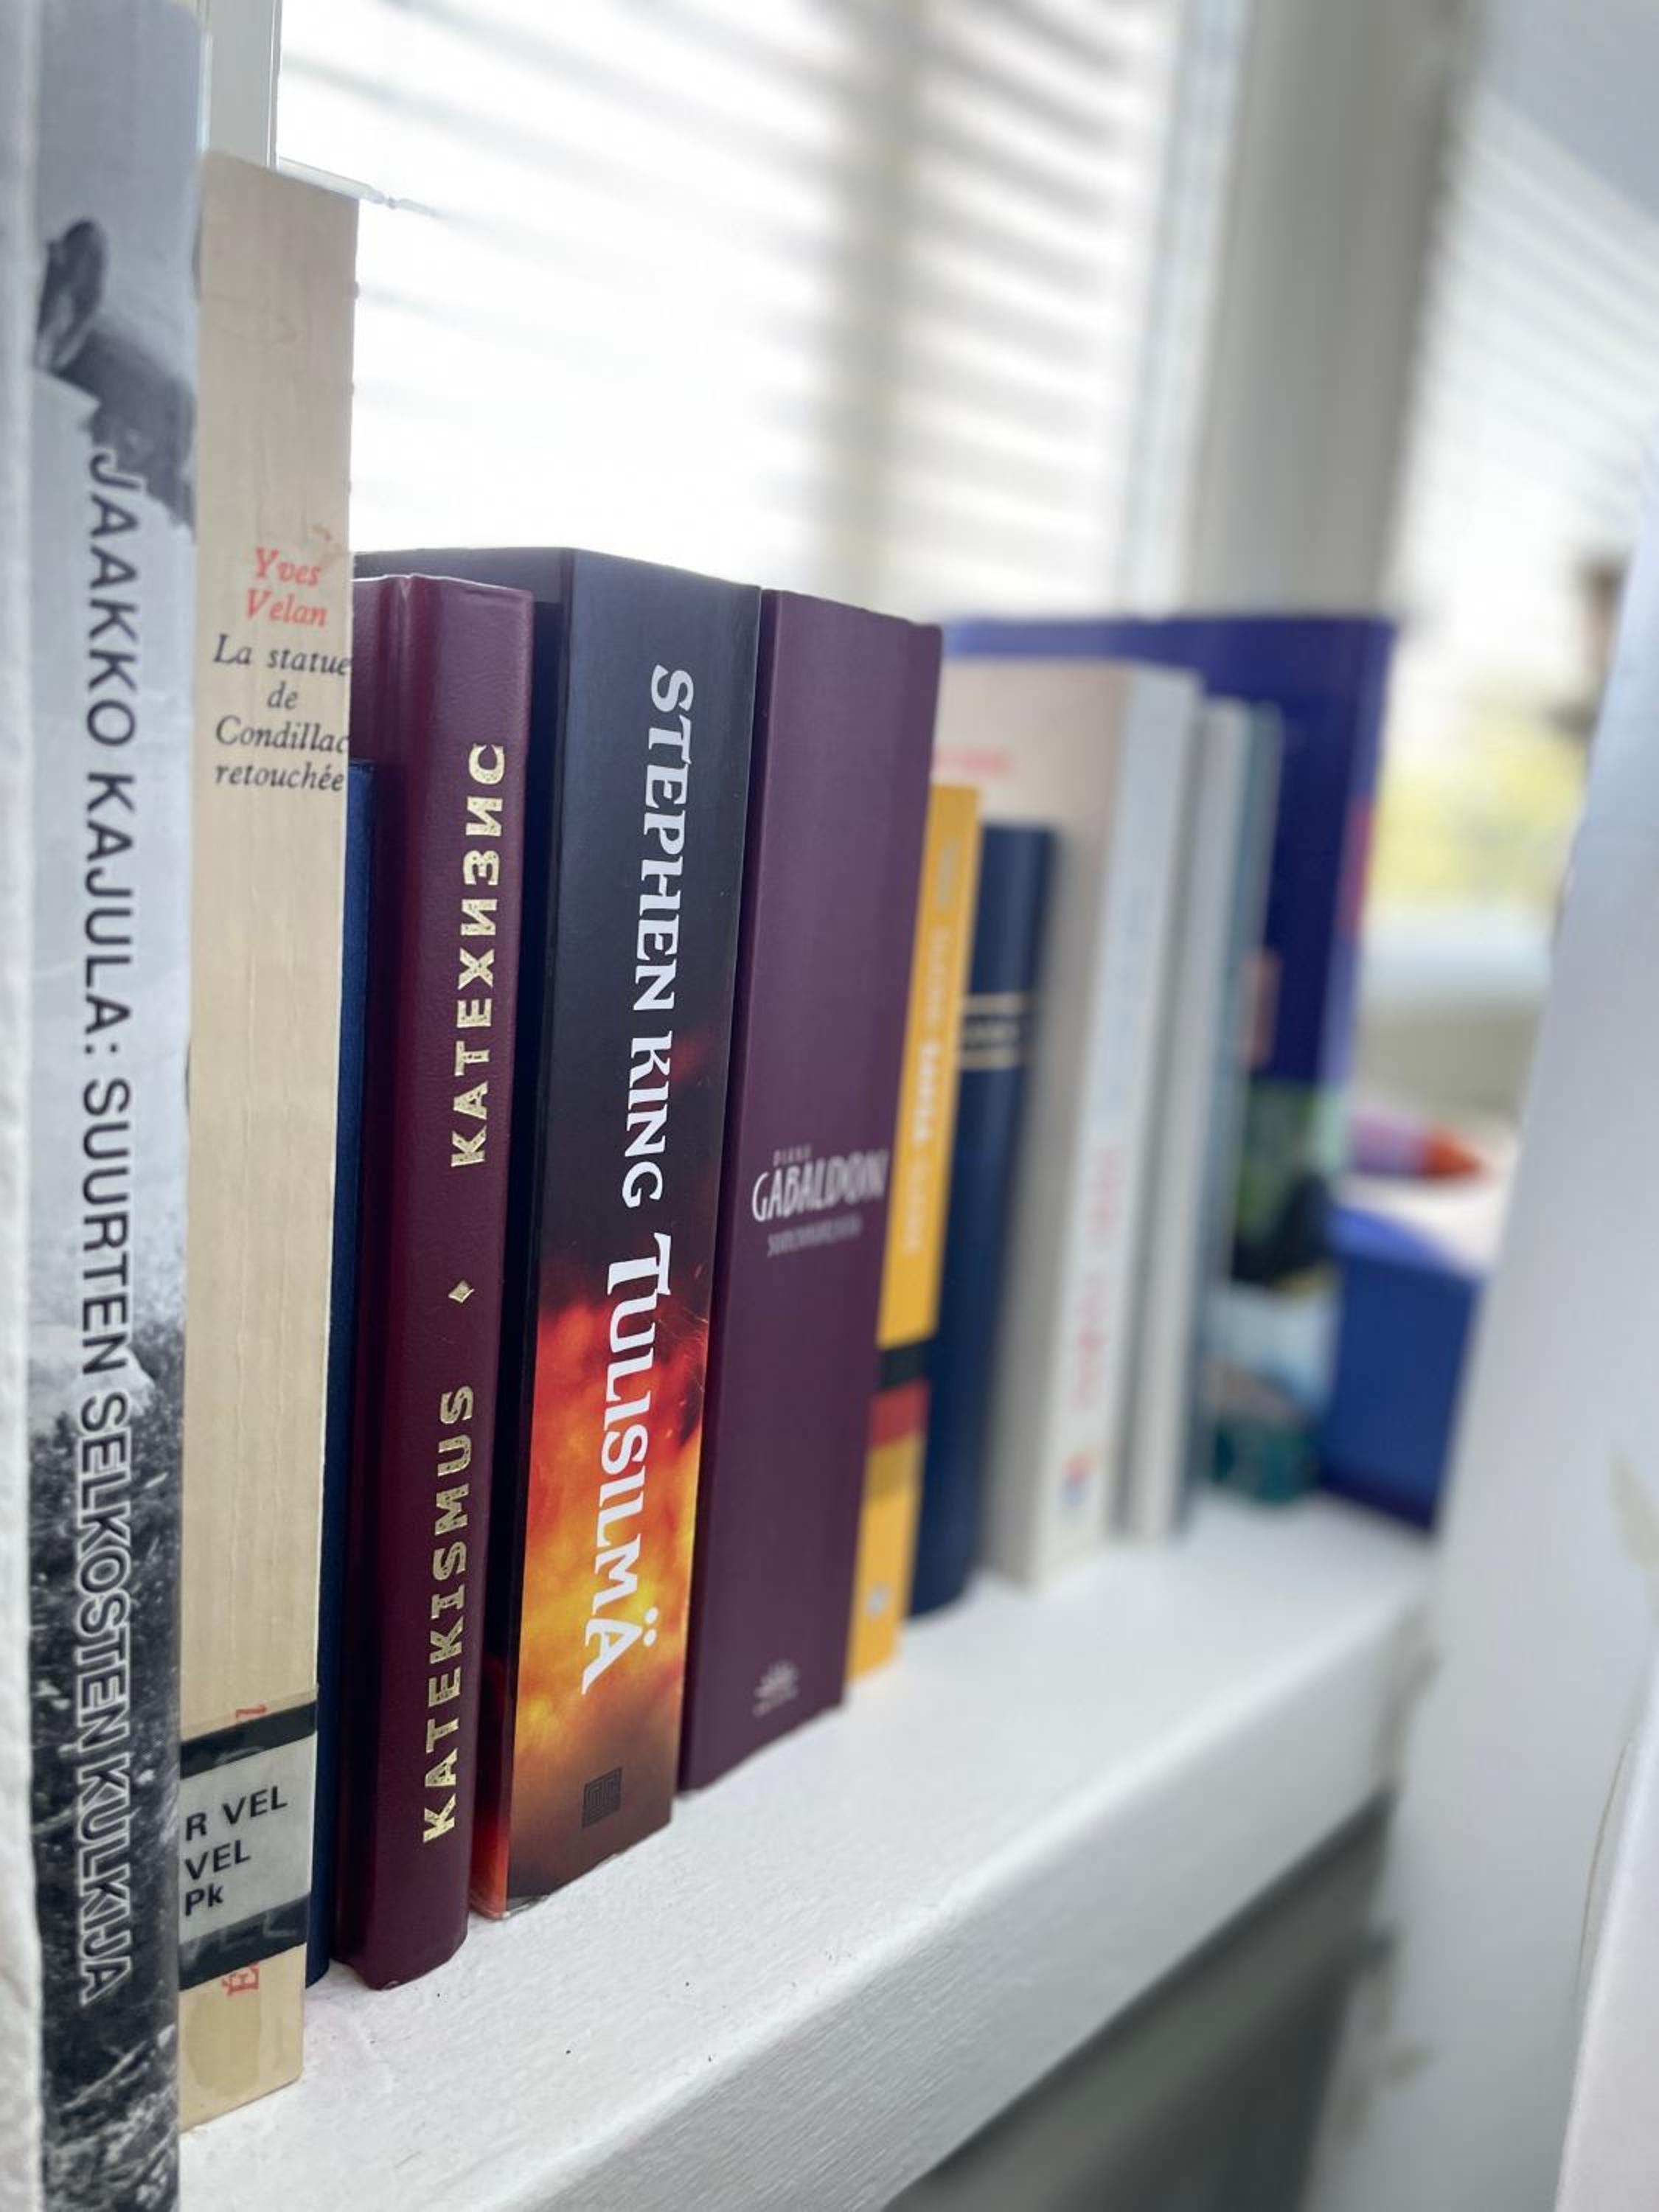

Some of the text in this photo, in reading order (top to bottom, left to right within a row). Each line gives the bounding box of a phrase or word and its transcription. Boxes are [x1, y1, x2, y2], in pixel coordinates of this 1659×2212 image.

[254, 547, 321, 586] Yves
[246, 588, 327, 627] Velan
[213, 633, 351, 676] La statue
[266, 681, 299, 710] de
[215, 714, 348, 754] Condillac
[215, 762, 344, 793] retouchée
[451, 742, 506, 1167] КАТЕХИЗИС
[621, 664, 695, 1208] STEPHEN KING
[77, 450, 141, 2007] JAAKKO KAJULA: SUURTEN SELKOSTEN KULKIJA
[580, 1232, 672, 1695] TULISILMÄ
[422, 1385, 475, 1843] KATEKISMUS
[184, 1785, 288, 1842] R VEL
[184, 1840, 251, 1880] VEL
[184, 1883, 224, 1917] Pk
